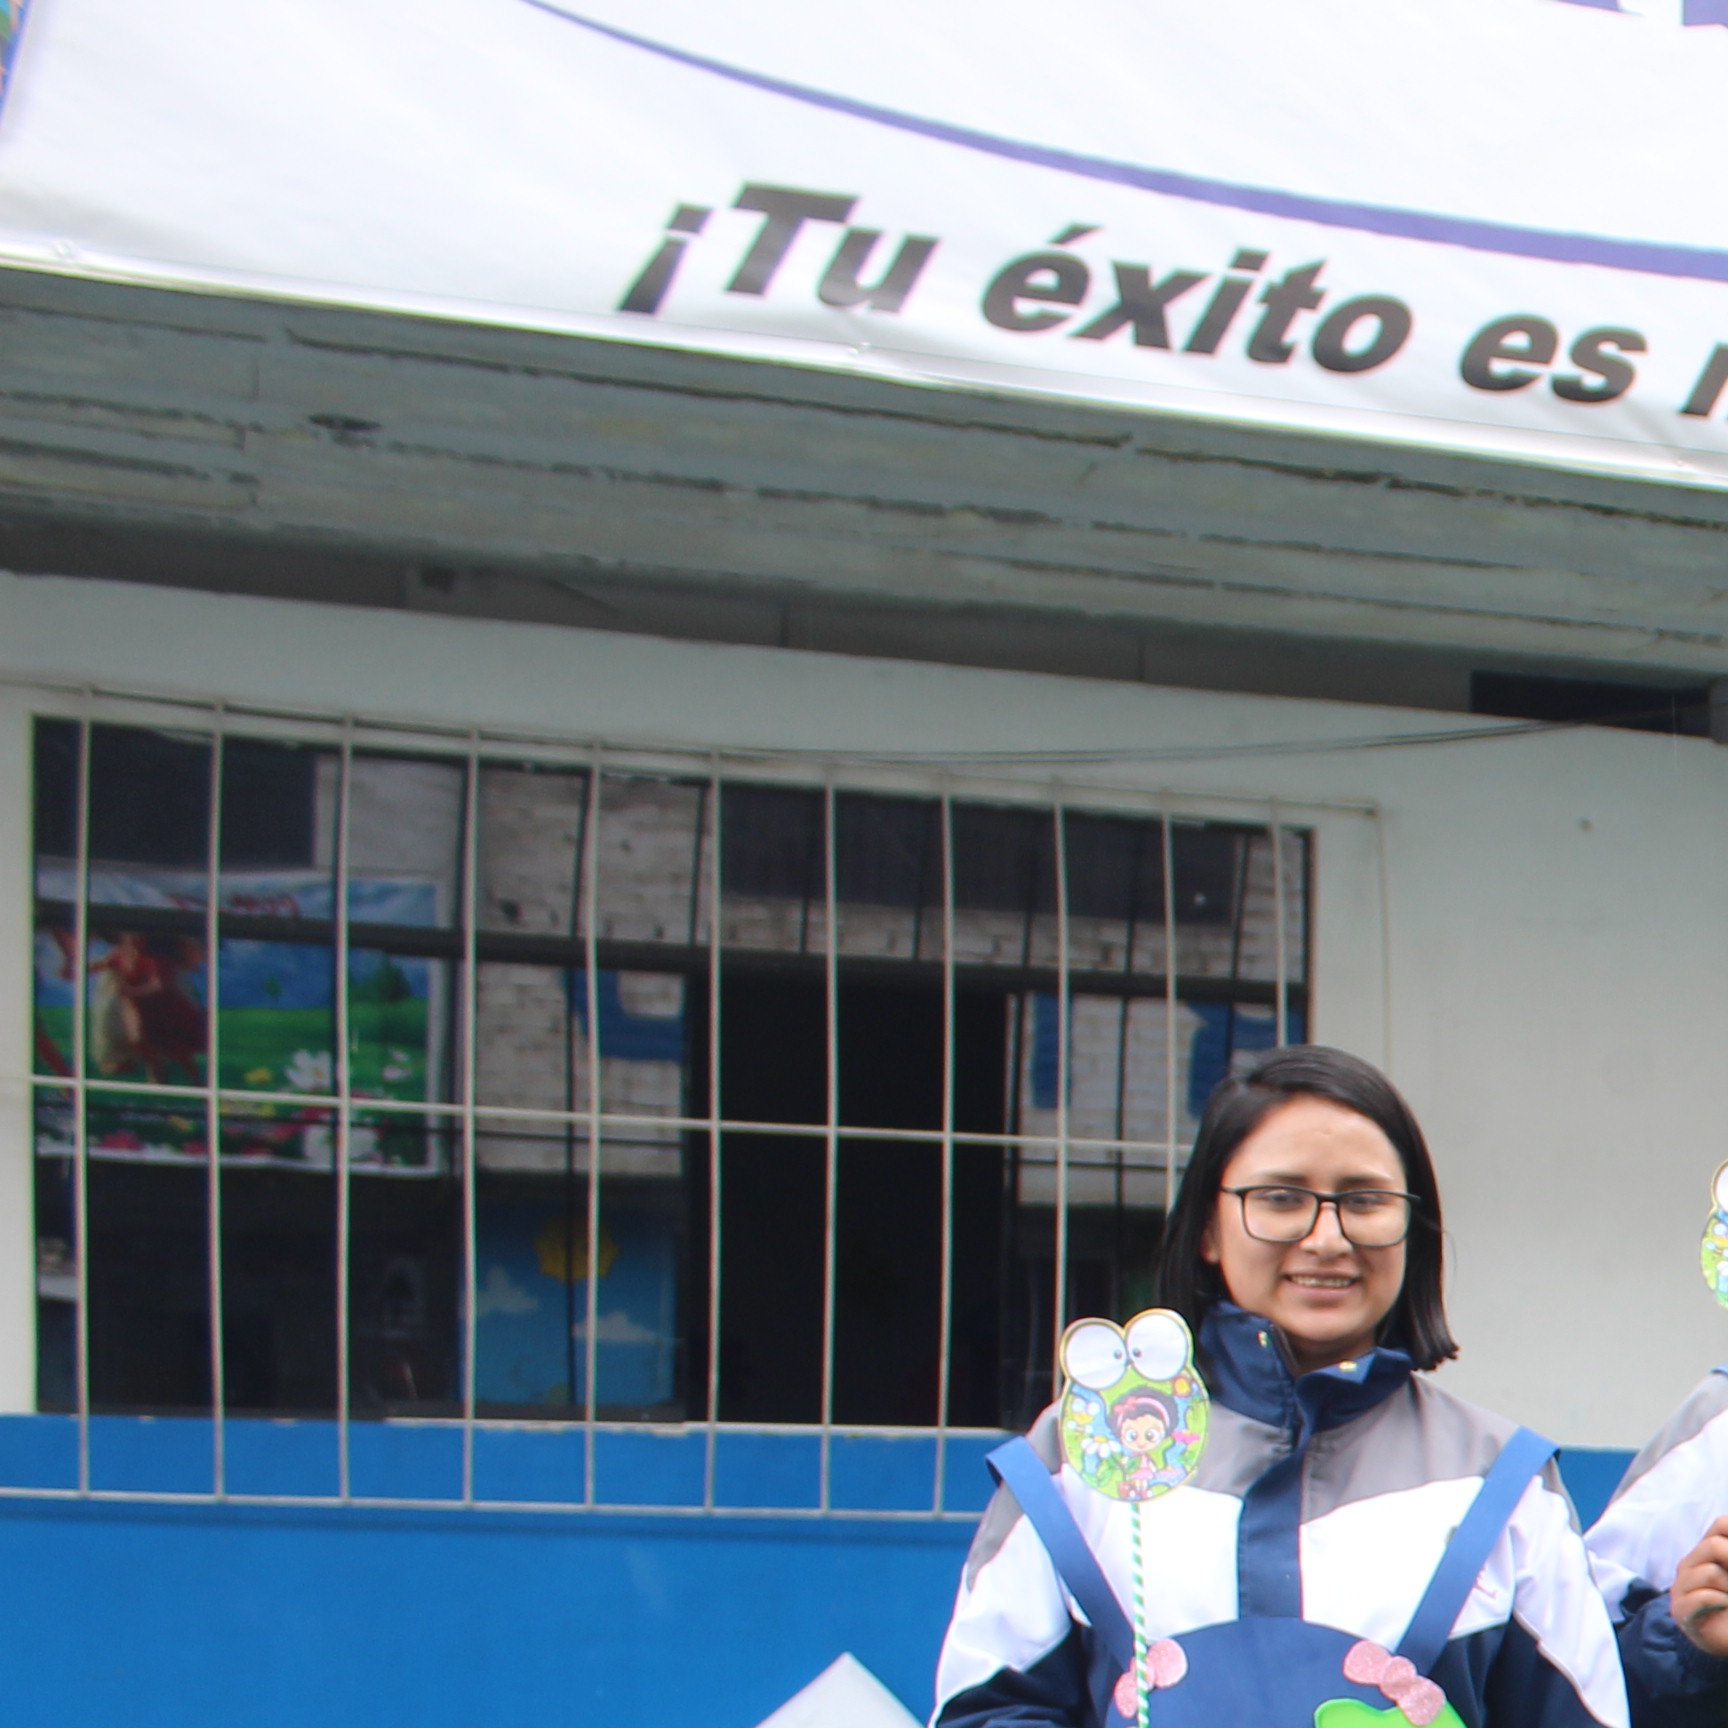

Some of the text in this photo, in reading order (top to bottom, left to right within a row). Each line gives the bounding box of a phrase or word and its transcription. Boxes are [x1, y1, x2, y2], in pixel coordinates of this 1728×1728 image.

[616, 180, 942, 317] ¡Tu
[981, 222, 1414, 374] éxito
[1458, 312, 1650, 404] es
